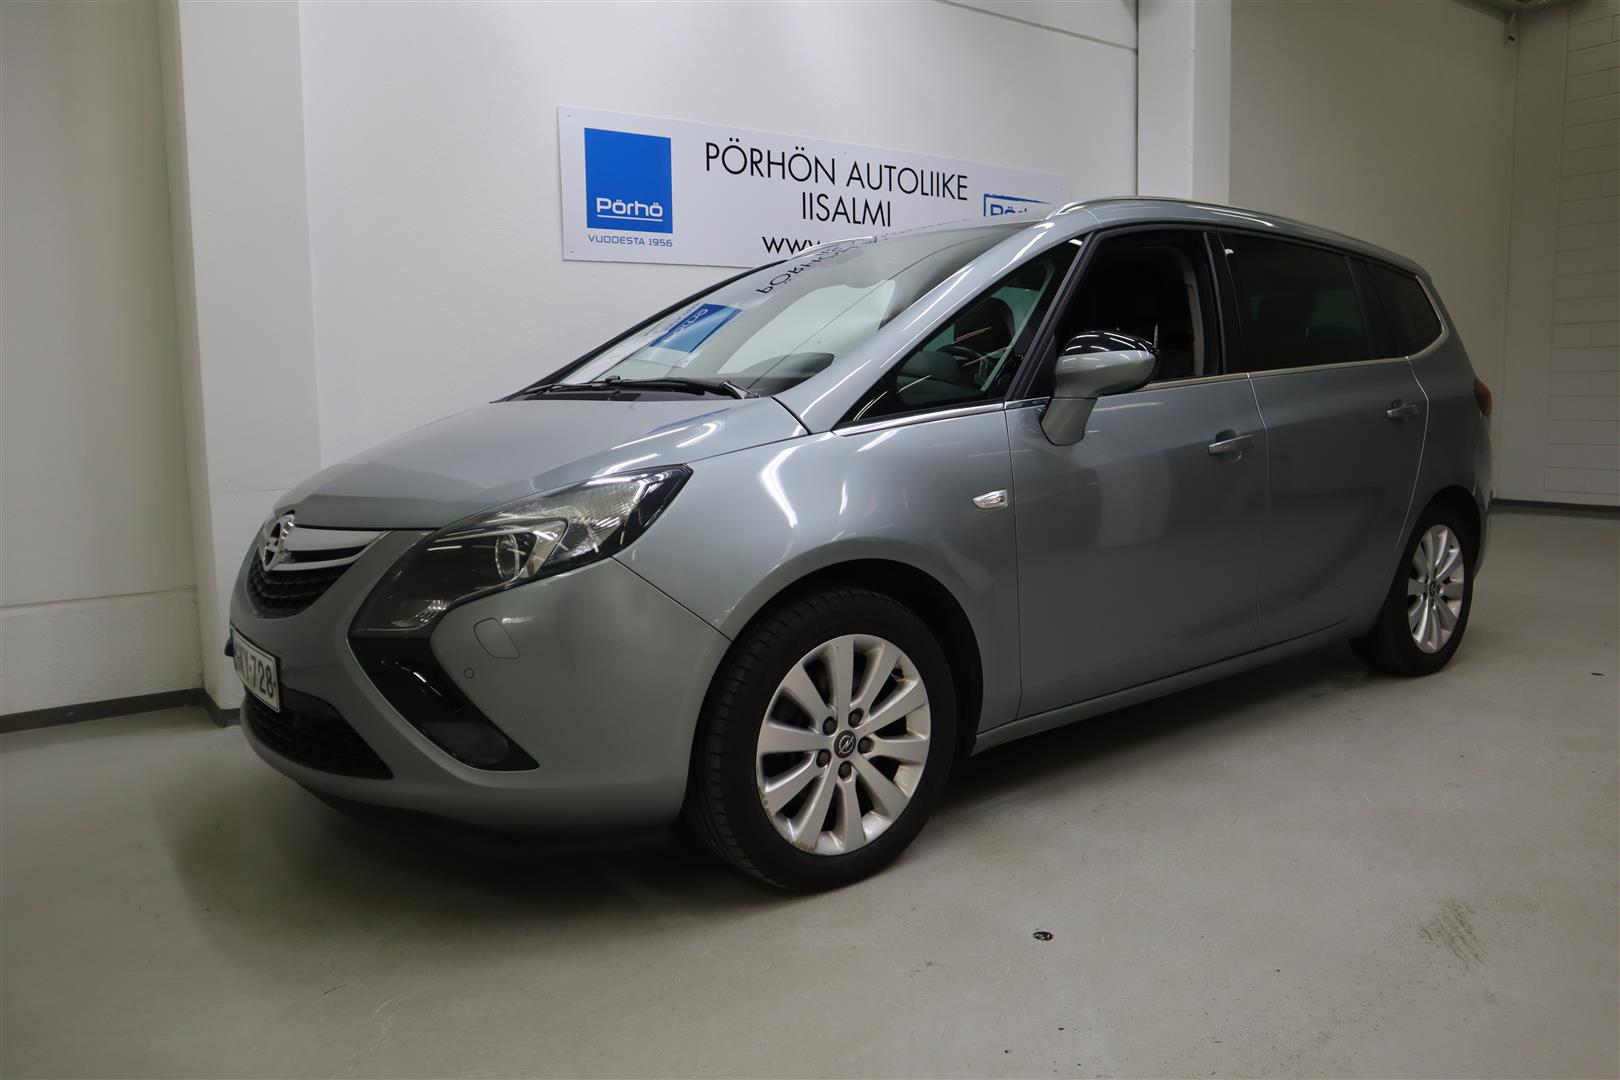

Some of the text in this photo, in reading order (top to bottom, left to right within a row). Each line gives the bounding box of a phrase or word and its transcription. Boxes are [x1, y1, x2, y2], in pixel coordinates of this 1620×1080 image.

[705, 137, 968, 201] PÖRHÖN AUTOLIIKE
[596, 197, 664, 217] Pörhö
[802, 191, 892, 227] IISALMI
[587, 234, 673, 248] VUODESTA 1956
